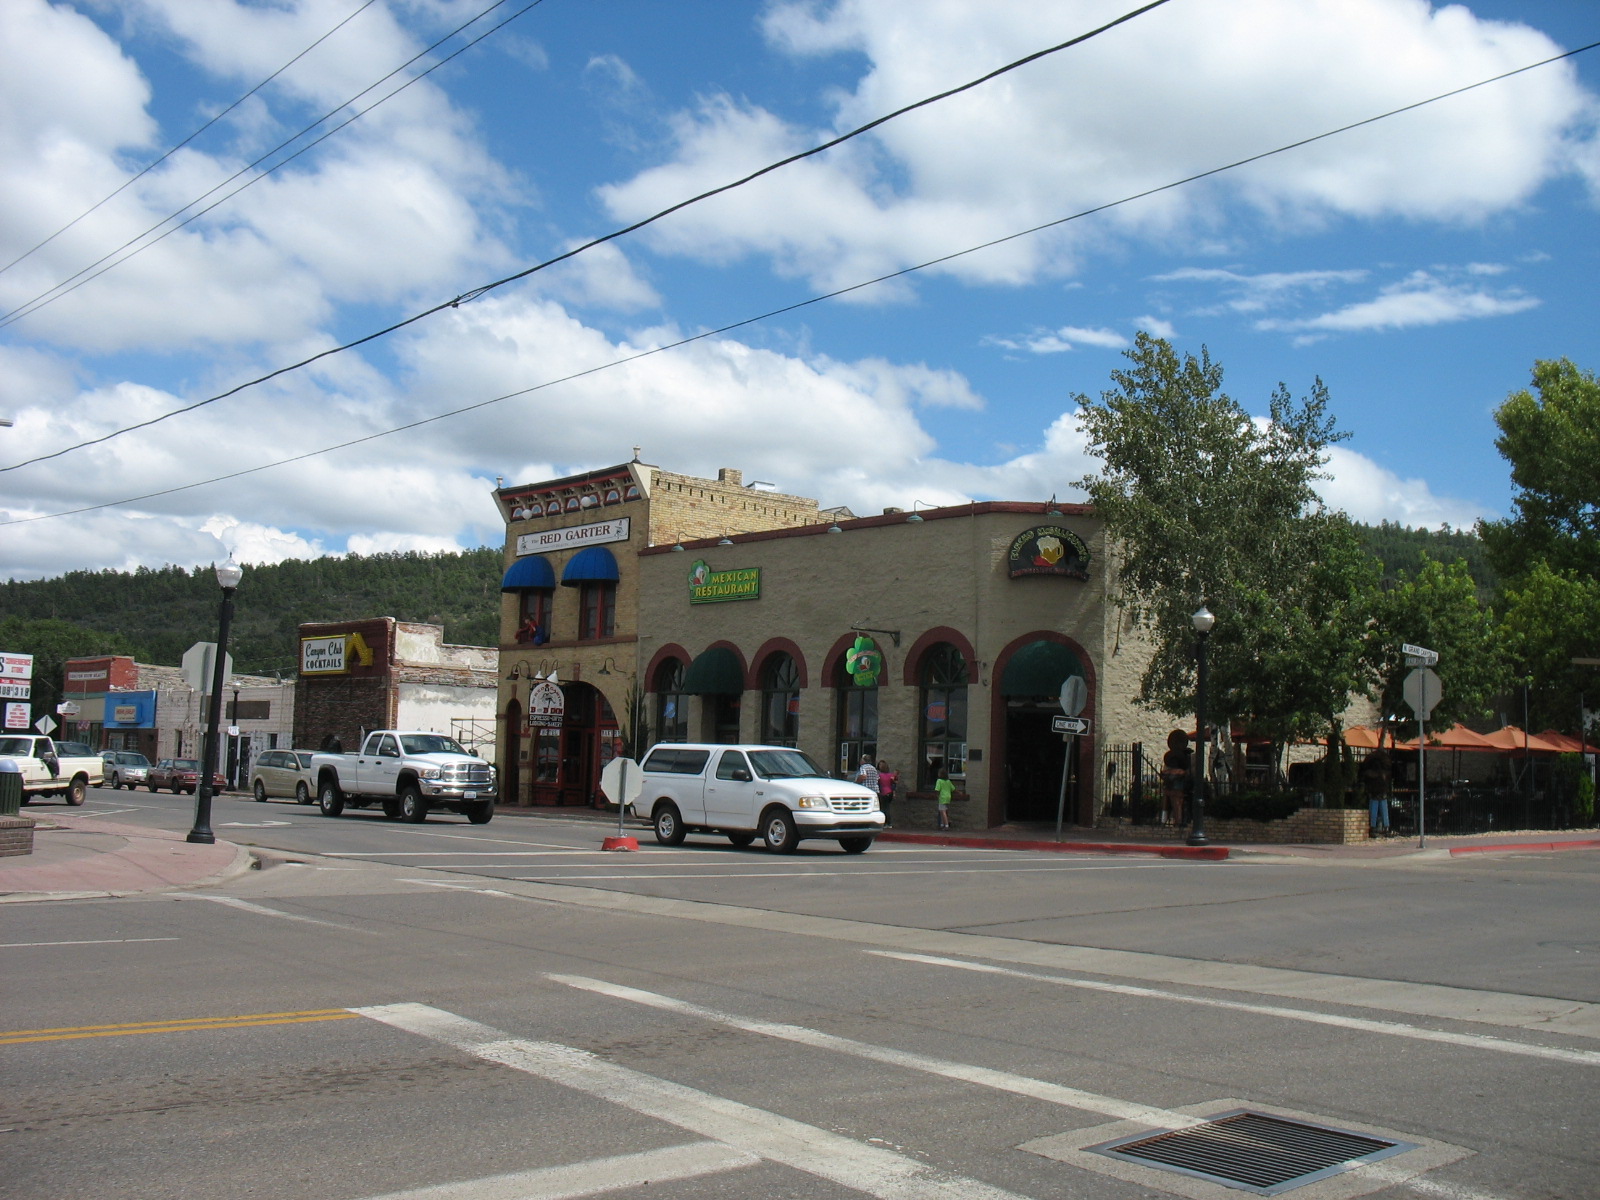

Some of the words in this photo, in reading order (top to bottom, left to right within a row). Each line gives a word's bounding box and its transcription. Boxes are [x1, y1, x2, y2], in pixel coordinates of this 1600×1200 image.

[540, 533, 561, 545] RED
[565, 525, 611, 541] GARTER
[712, 571, 757, 584] MEXICAN
[695, 582, 757, 597] RESTAURANT
[305, 643, 326, 660] Canyon
[328, 641, 343, 656] Club
[305, 659, 342, 669] COCKTAILS
